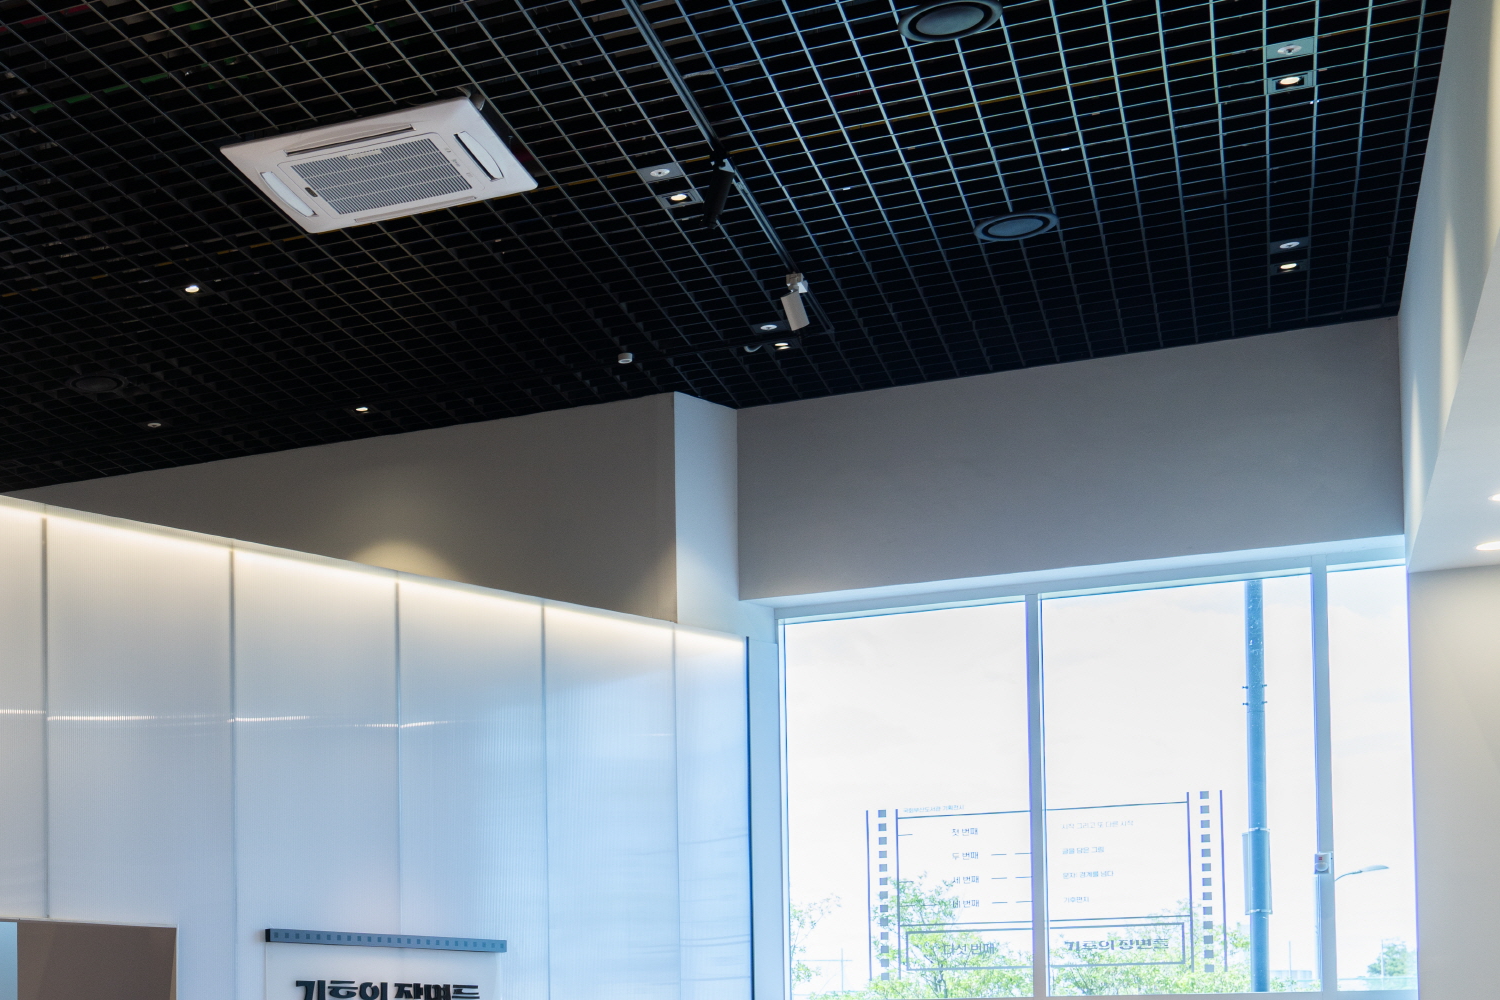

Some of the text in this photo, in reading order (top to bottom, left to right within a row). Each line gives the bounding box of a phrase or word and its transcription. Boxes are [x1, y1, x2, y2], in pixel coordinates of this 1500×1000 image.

[952, 828, 978, 836] 첫 번째
[962, 852, 978, 860] 번째
[962, 876, 979, 884] 번째
[962, 900, 980, 908] 번째
[943, 943, 995, 955] 다섯 번째
